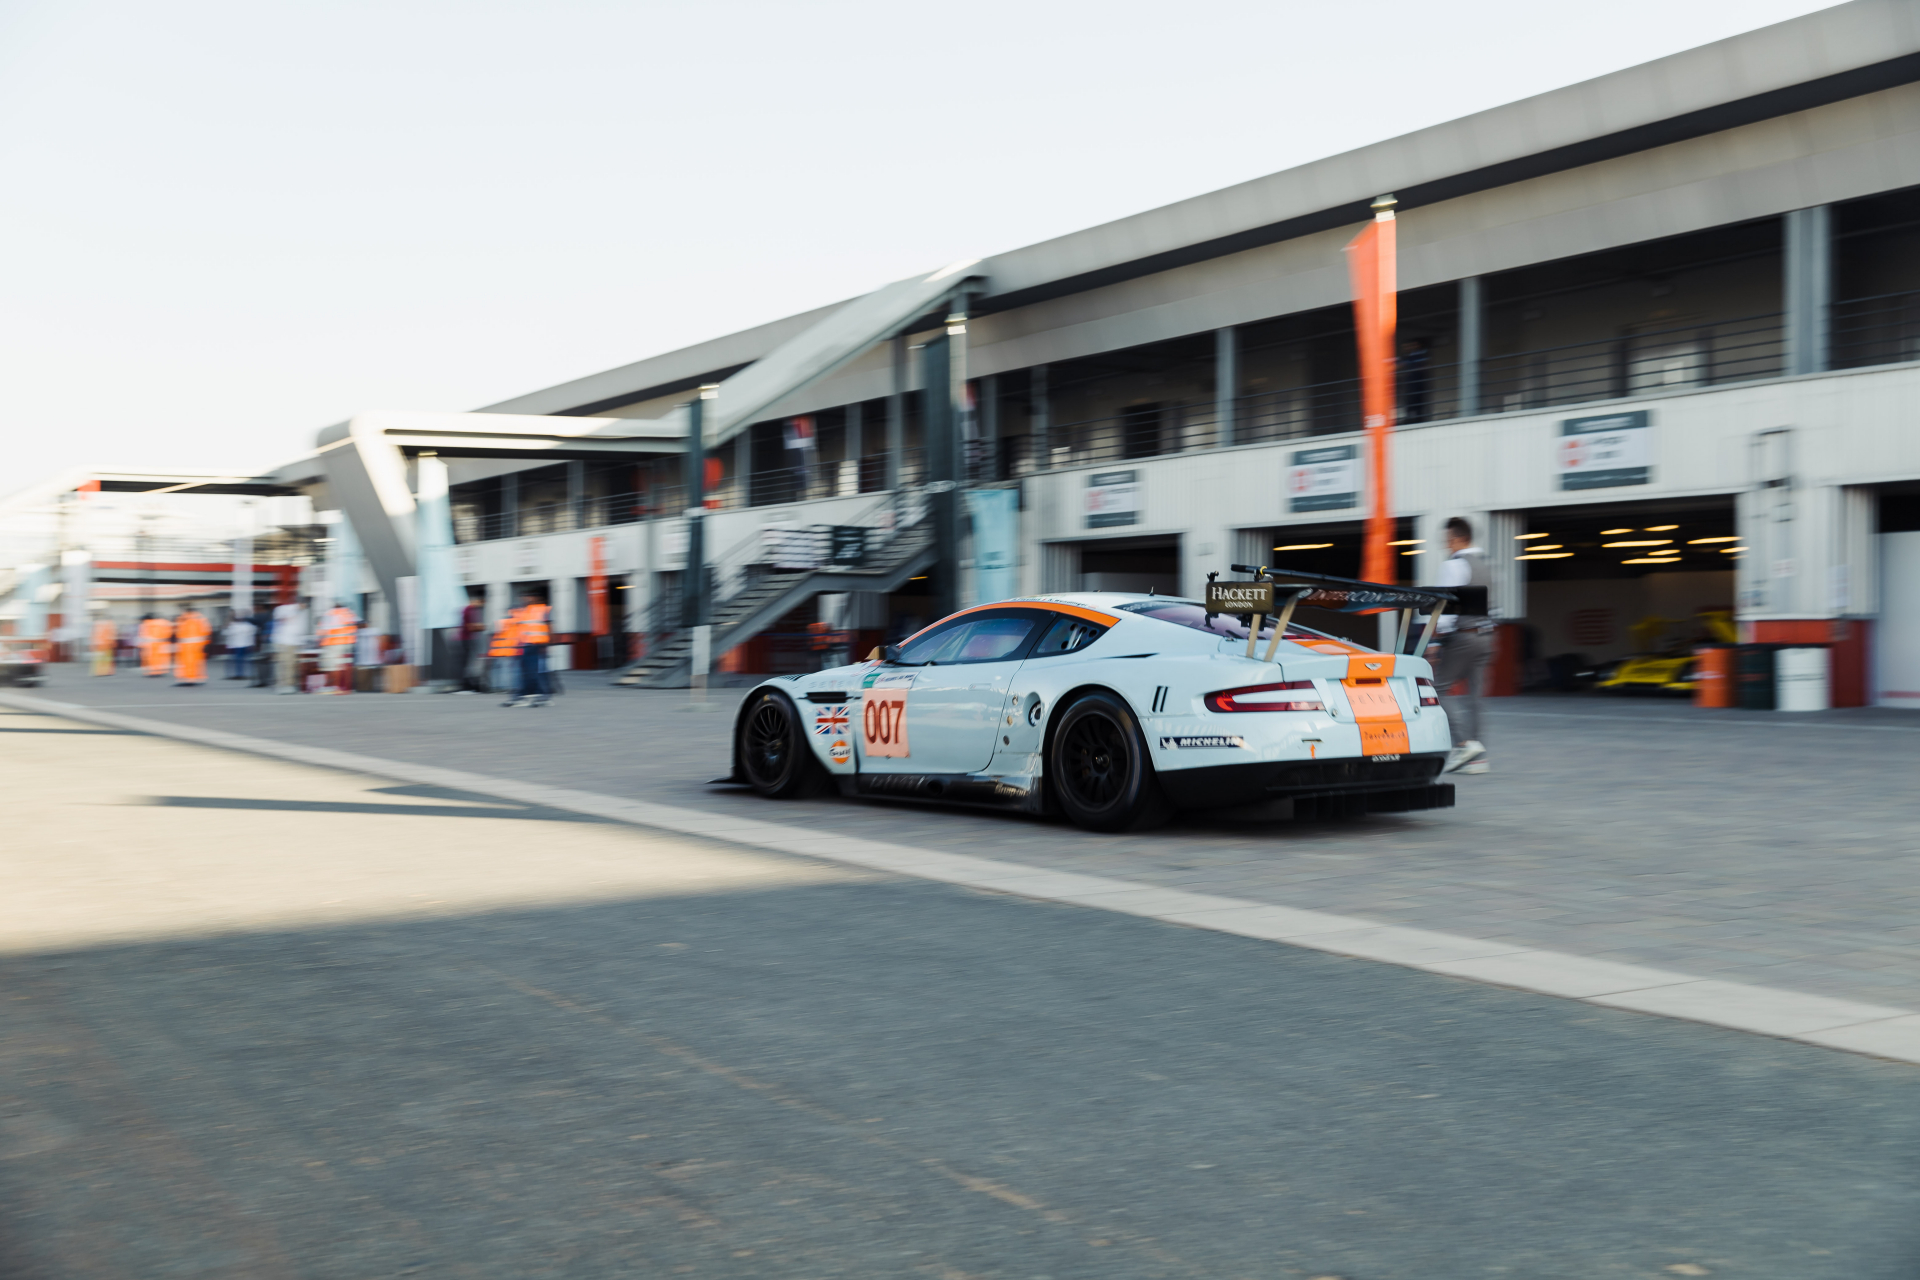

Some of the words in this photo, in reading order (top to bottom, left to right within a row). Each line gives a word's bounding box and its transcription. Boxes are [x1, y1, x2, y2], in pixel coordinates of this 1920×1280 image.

[1211, 586, 1268, 600] HACKETT
[865, 699, 905, 745] 007
[1180, 737, 1241, 747] MICHELIN
